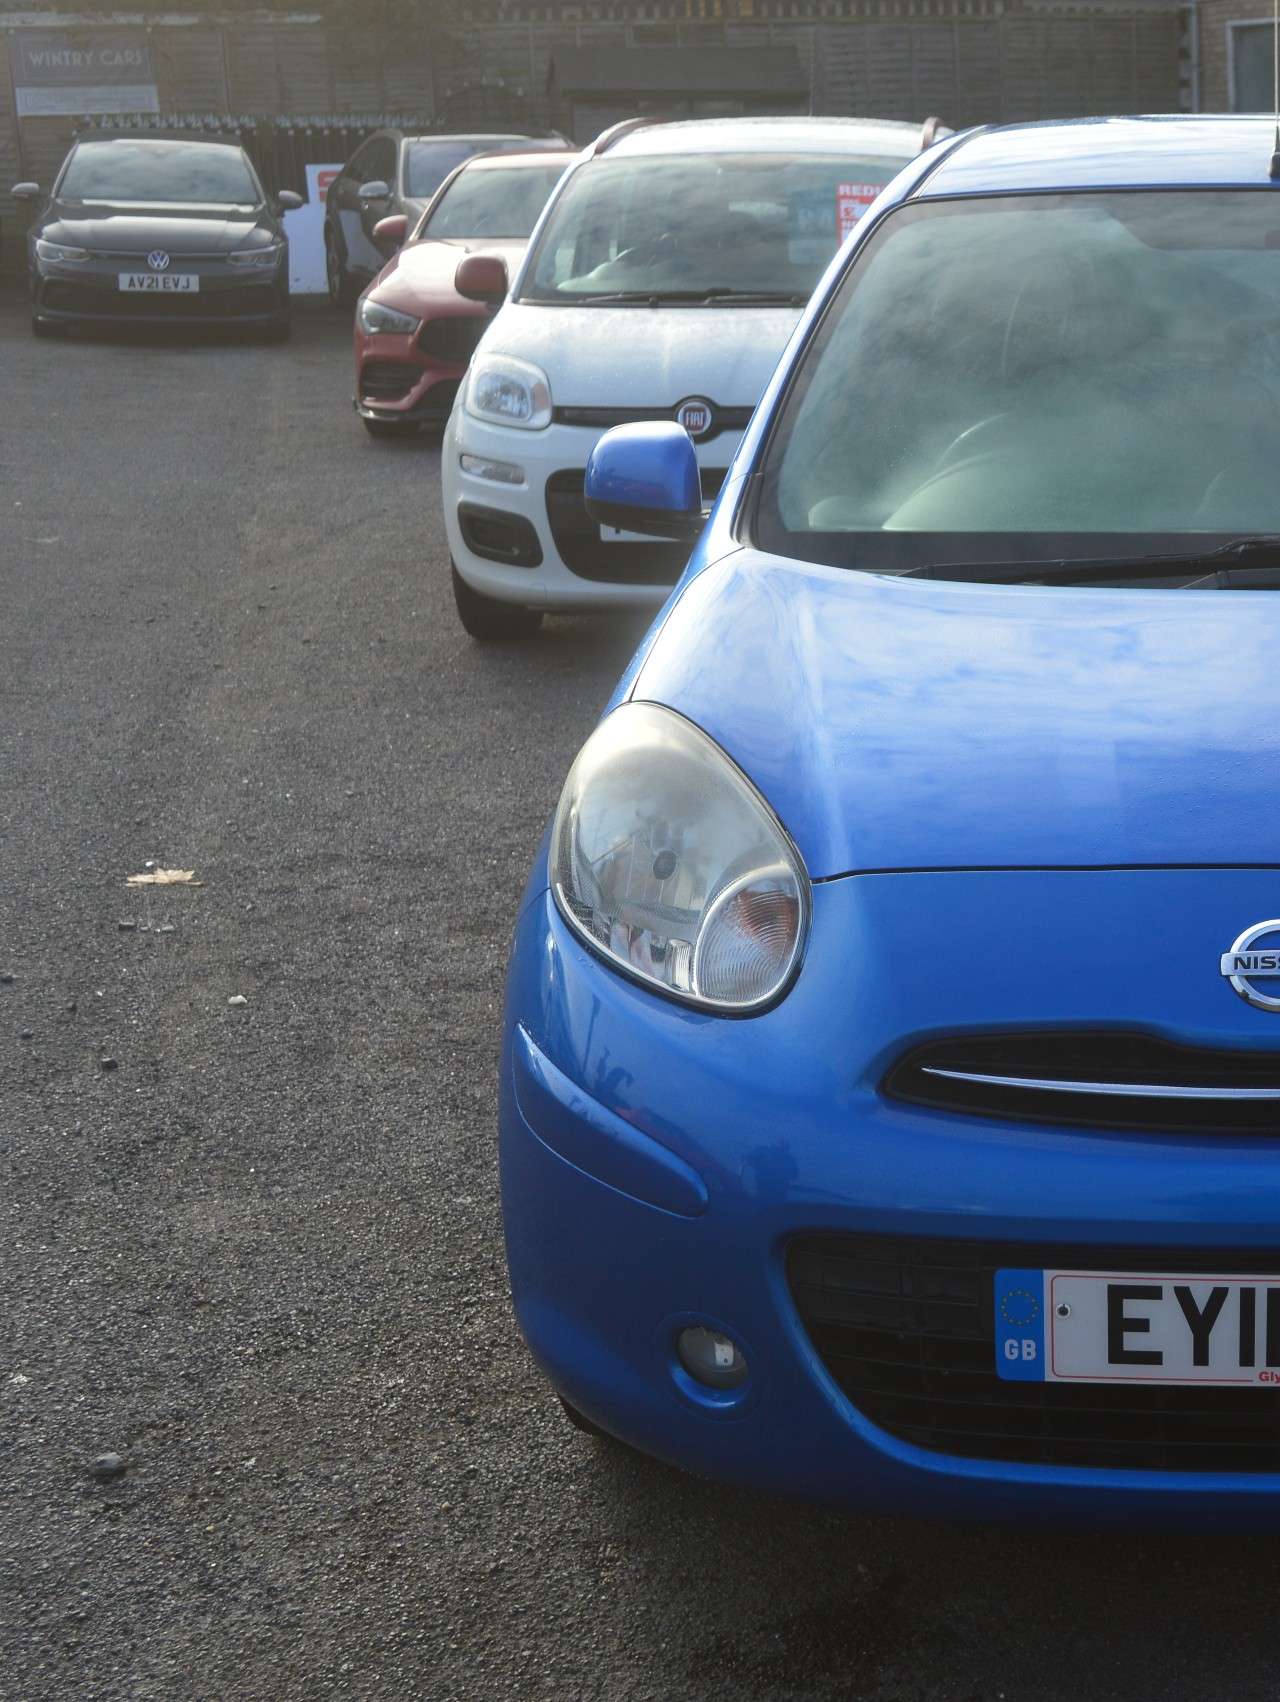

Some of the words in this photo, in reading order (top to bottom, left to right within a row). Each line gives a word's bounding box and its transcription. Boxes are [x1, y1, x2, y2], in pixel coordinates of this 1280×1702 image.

[29, 50, 94, 66] WINTRY
[100, 49, 143, 65] CARS
[128, 275, 159, 289] AV21
[163, 276, 190, 289] EVJ
[1004, 1339, 1037, 1361] GB
